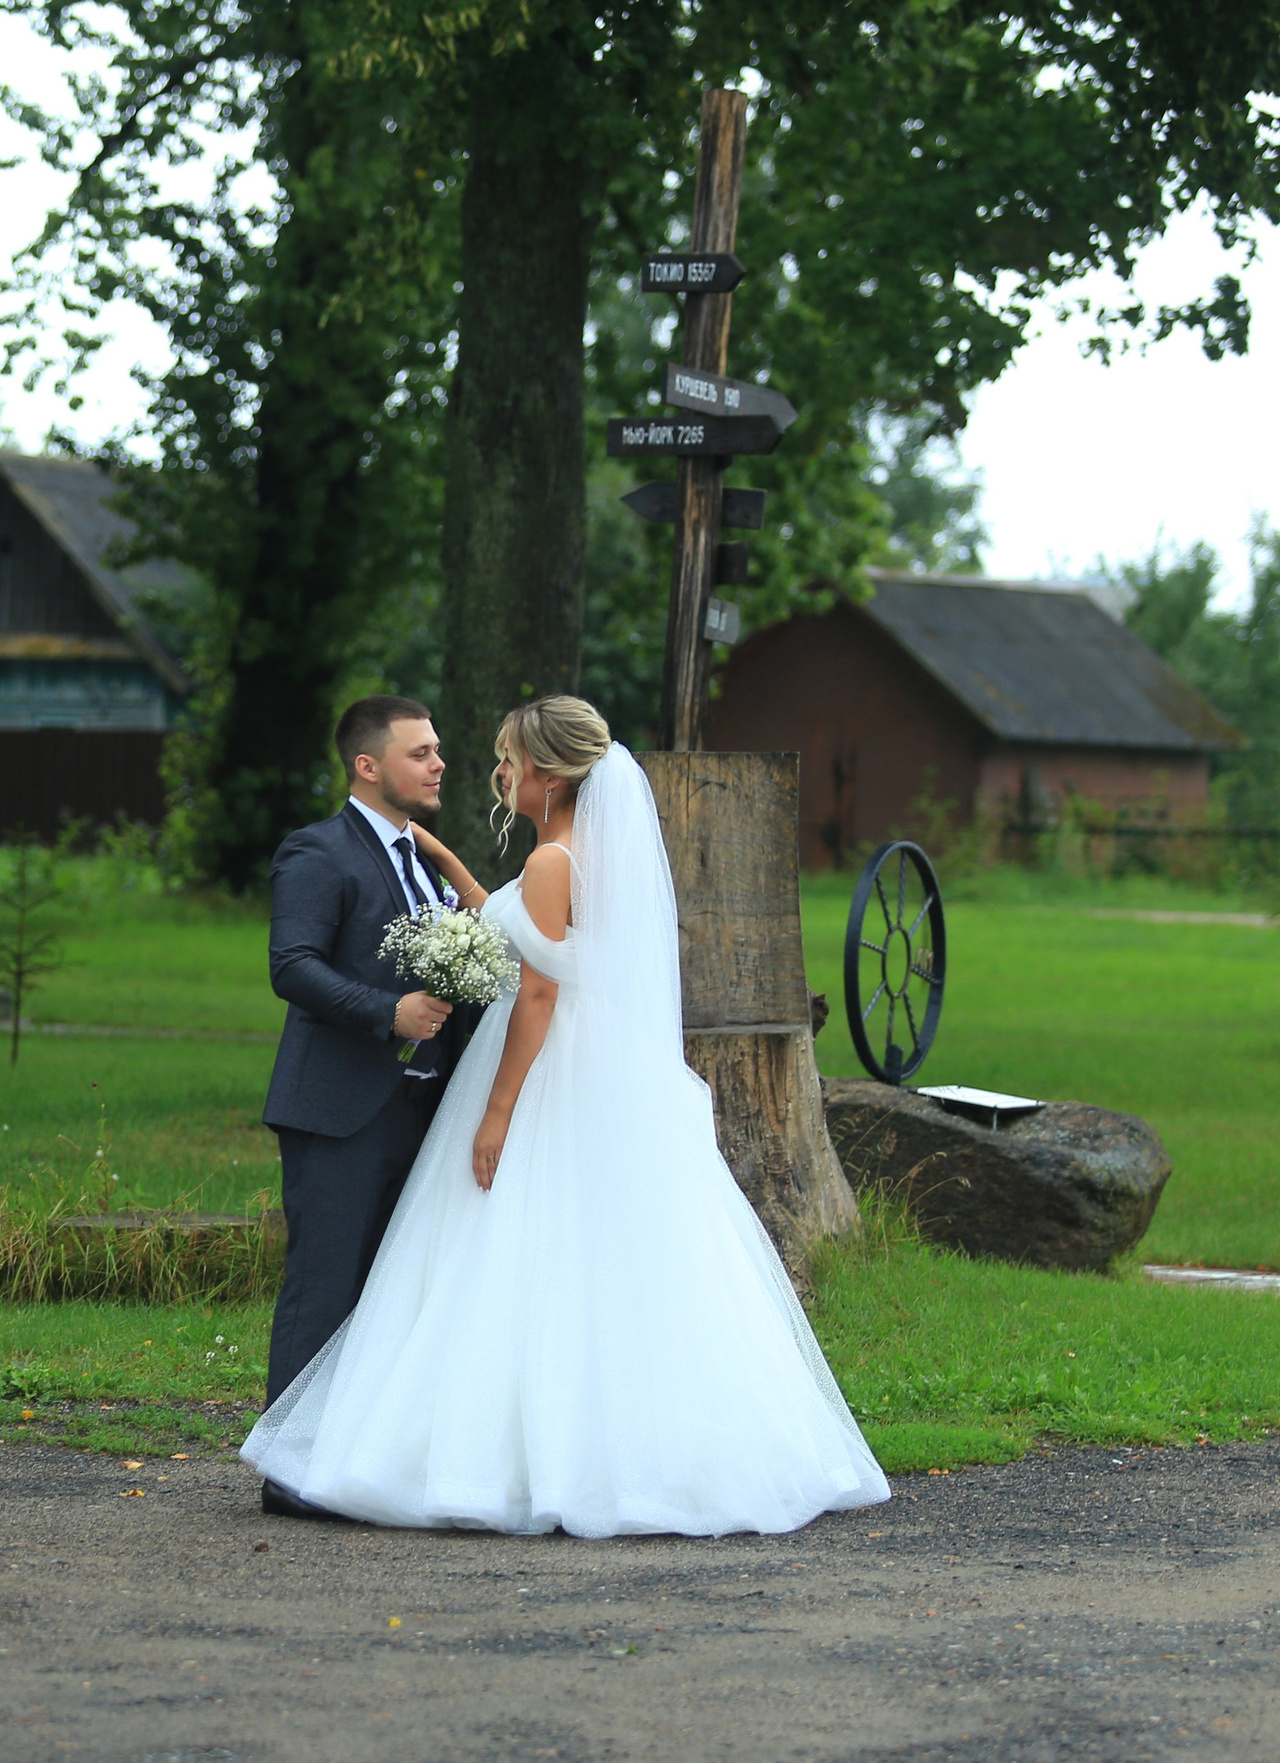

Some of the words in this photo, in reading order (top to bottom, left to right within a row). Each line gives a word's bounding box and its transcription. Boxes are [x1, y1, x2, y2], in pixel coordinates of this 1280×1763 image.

[648, 262, 684, 282] ТОКИО
[622, 422, 675, 445] НЬЮ-ЙОРК
[677, 425, 705, 445] 7265
